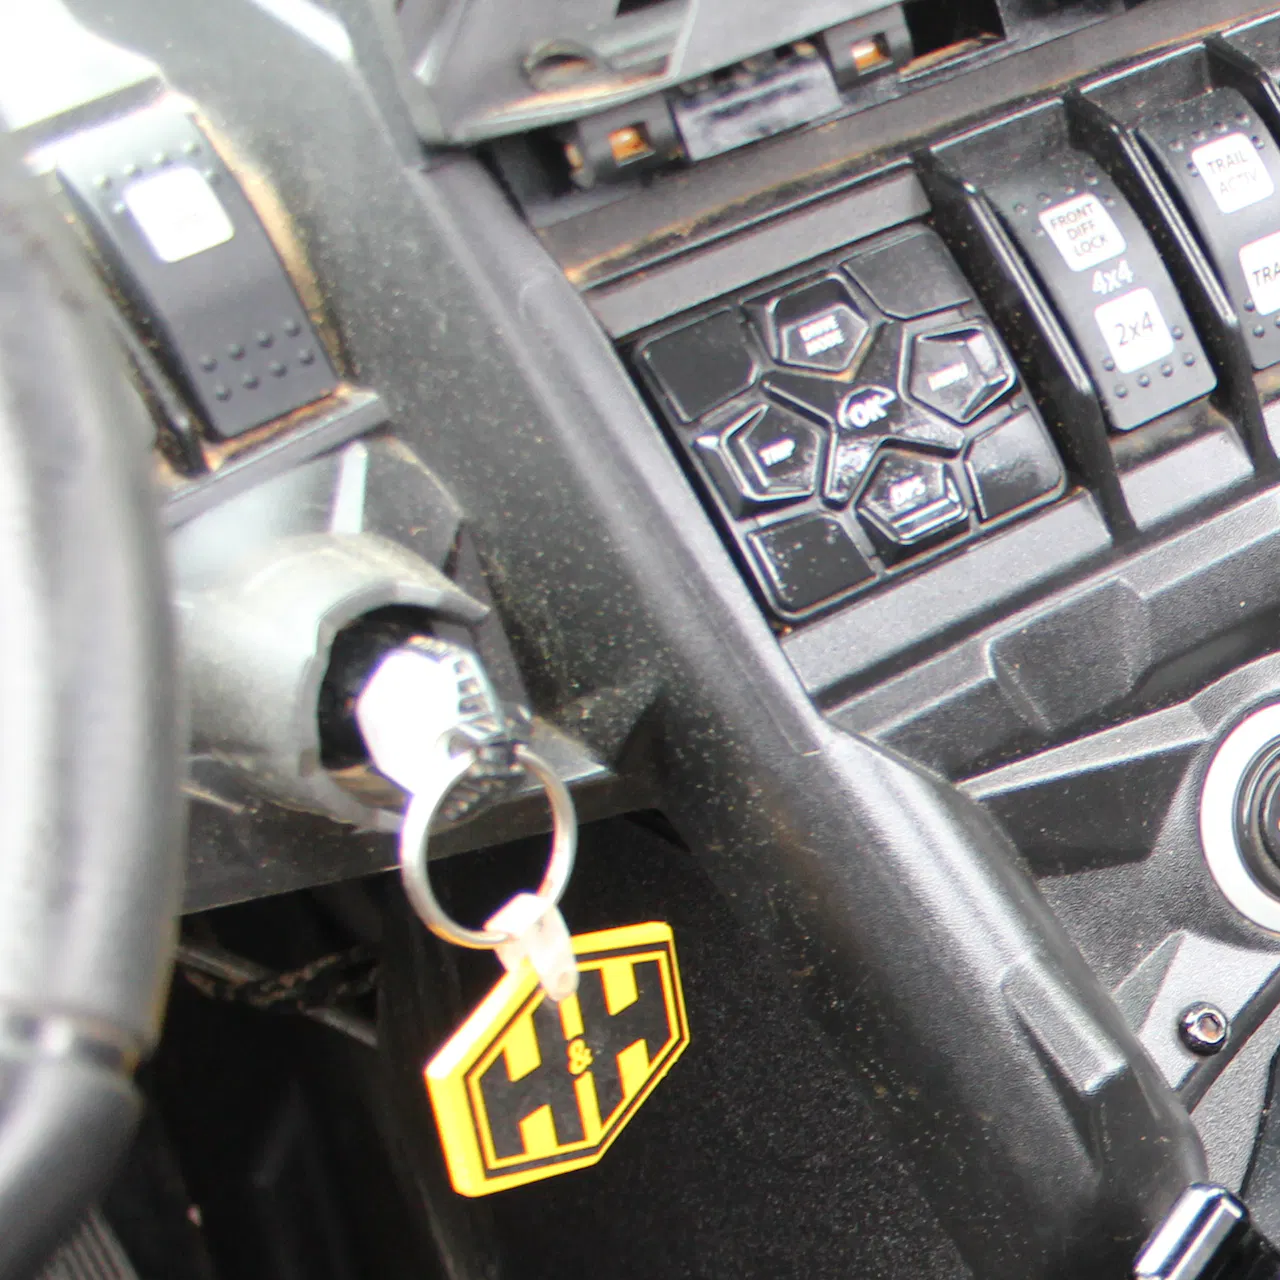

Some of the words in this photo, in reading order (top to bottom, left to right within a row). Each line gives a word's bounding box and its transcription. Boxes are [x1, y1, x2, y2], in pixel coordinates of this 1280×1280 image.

[1207, 150, 1249, 175] TRAIL
[1050, 202, 1094, 231] FRONT
[1066, 219, 1096, 241] DIFF
[1074, 234, 1108, 257] LOCK
[1092, 259, 1133, 294] 4x4
[1115, 311, 1154, 346] 2x4
[849, 397, 888, 429] OK
